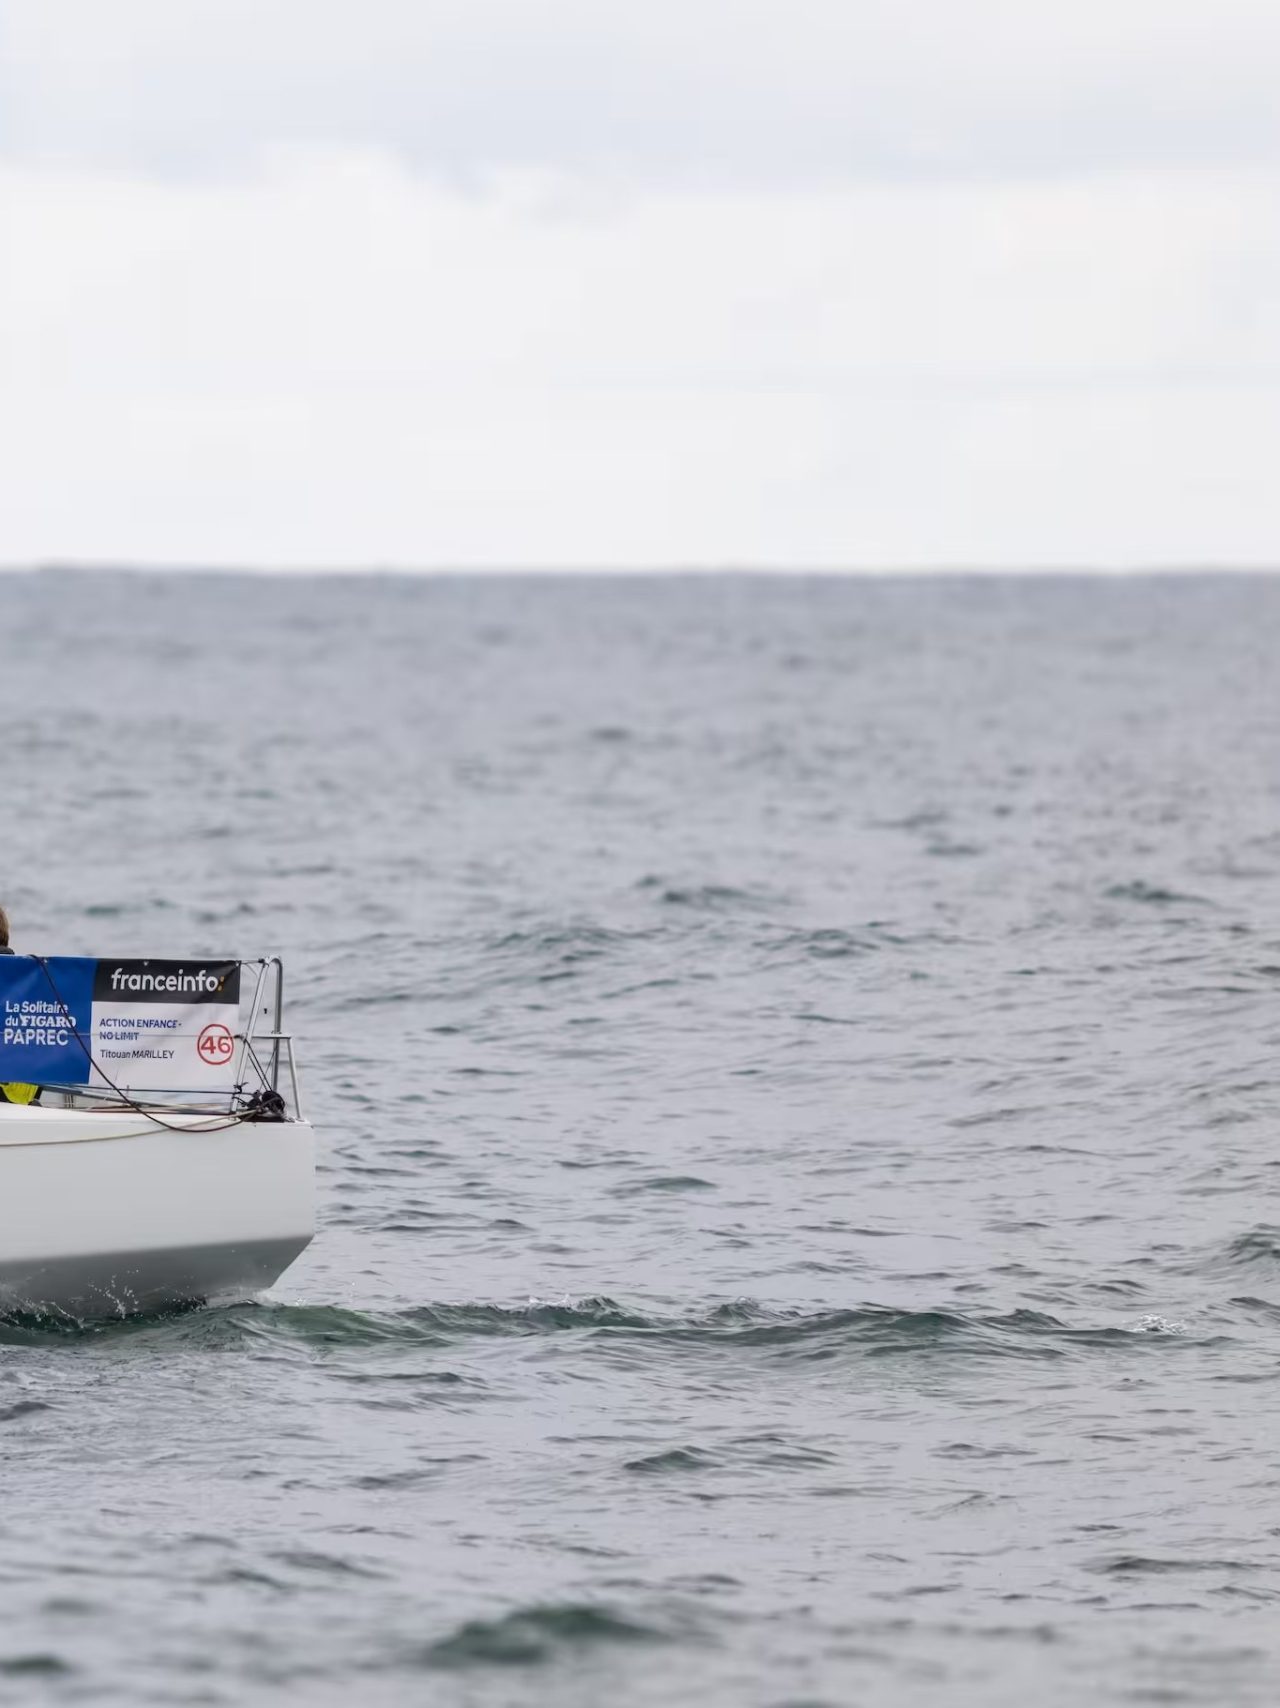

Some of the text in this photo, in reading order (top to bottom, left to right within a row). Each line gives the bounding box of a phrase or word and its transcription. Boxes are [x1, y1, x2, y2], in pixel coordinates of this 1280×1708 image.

[6, 1001, 68, 1014] La Solitaire
[5, 1014, 77, 1028] du FIGARO
[100, 1019, 135, 1028] ACTION
[137, 1019, 178, 1029] ENFANCE
[4, 1029, 69, 1046] PAPREC
[100, 1032, 139, 1041] NO LIMIT
[201, 1036, 231, 1055] 46
[100, 1049, 175, 1059] Titouan MARILLEY
